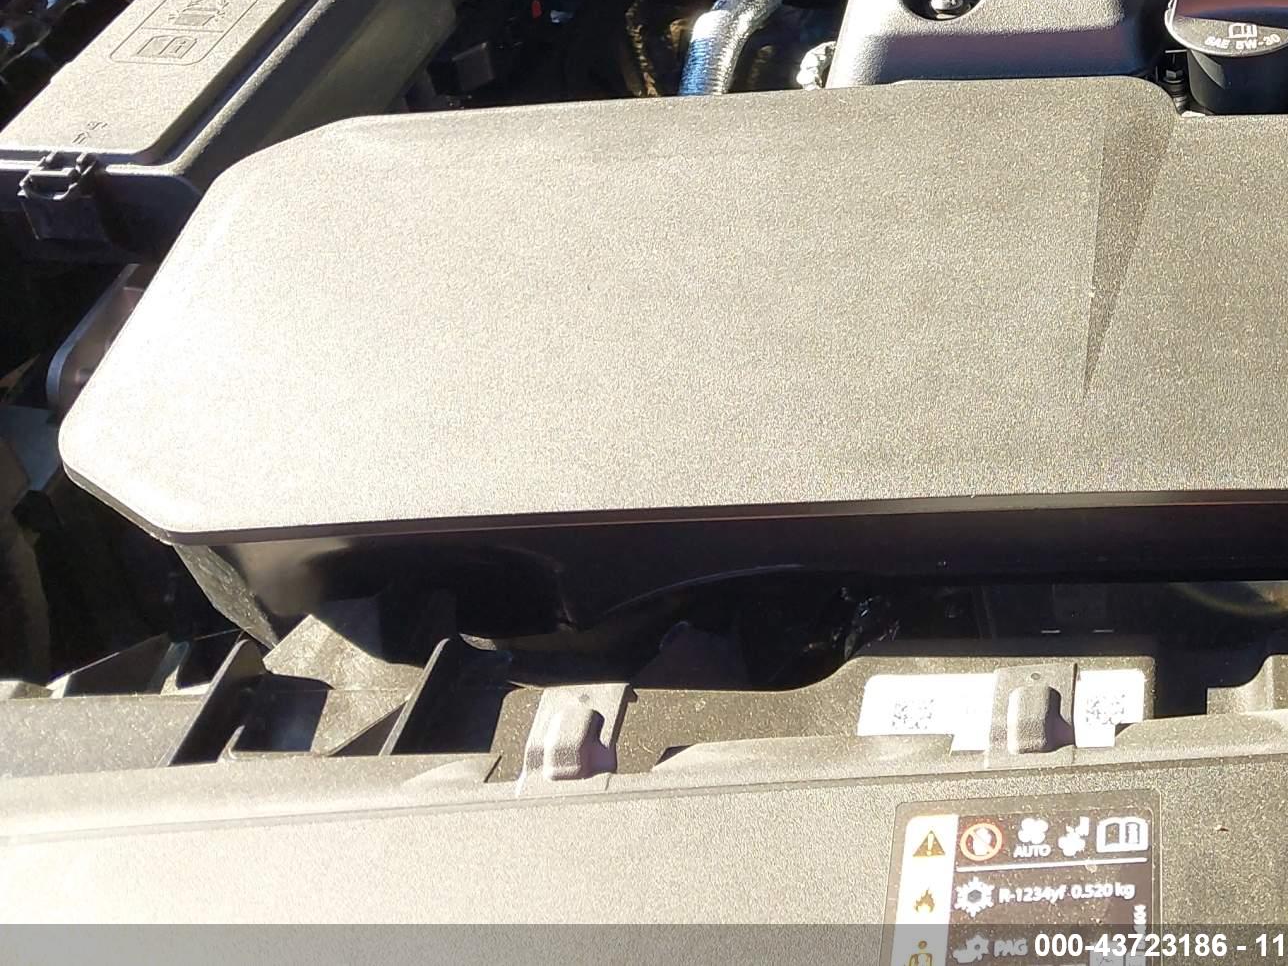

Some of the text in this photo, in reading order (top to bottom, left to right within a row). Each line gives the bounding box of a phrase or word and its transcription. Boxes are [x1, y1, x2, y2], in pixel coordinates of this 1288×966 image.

[1204, 34, 1281, 50] SAE 5W-30
[1013, 844, 1052, 858] AUTO
[998, 882, 1136, 904] R-1234yf 0.520 kg
[994, 938, 1028, 957] PAG
